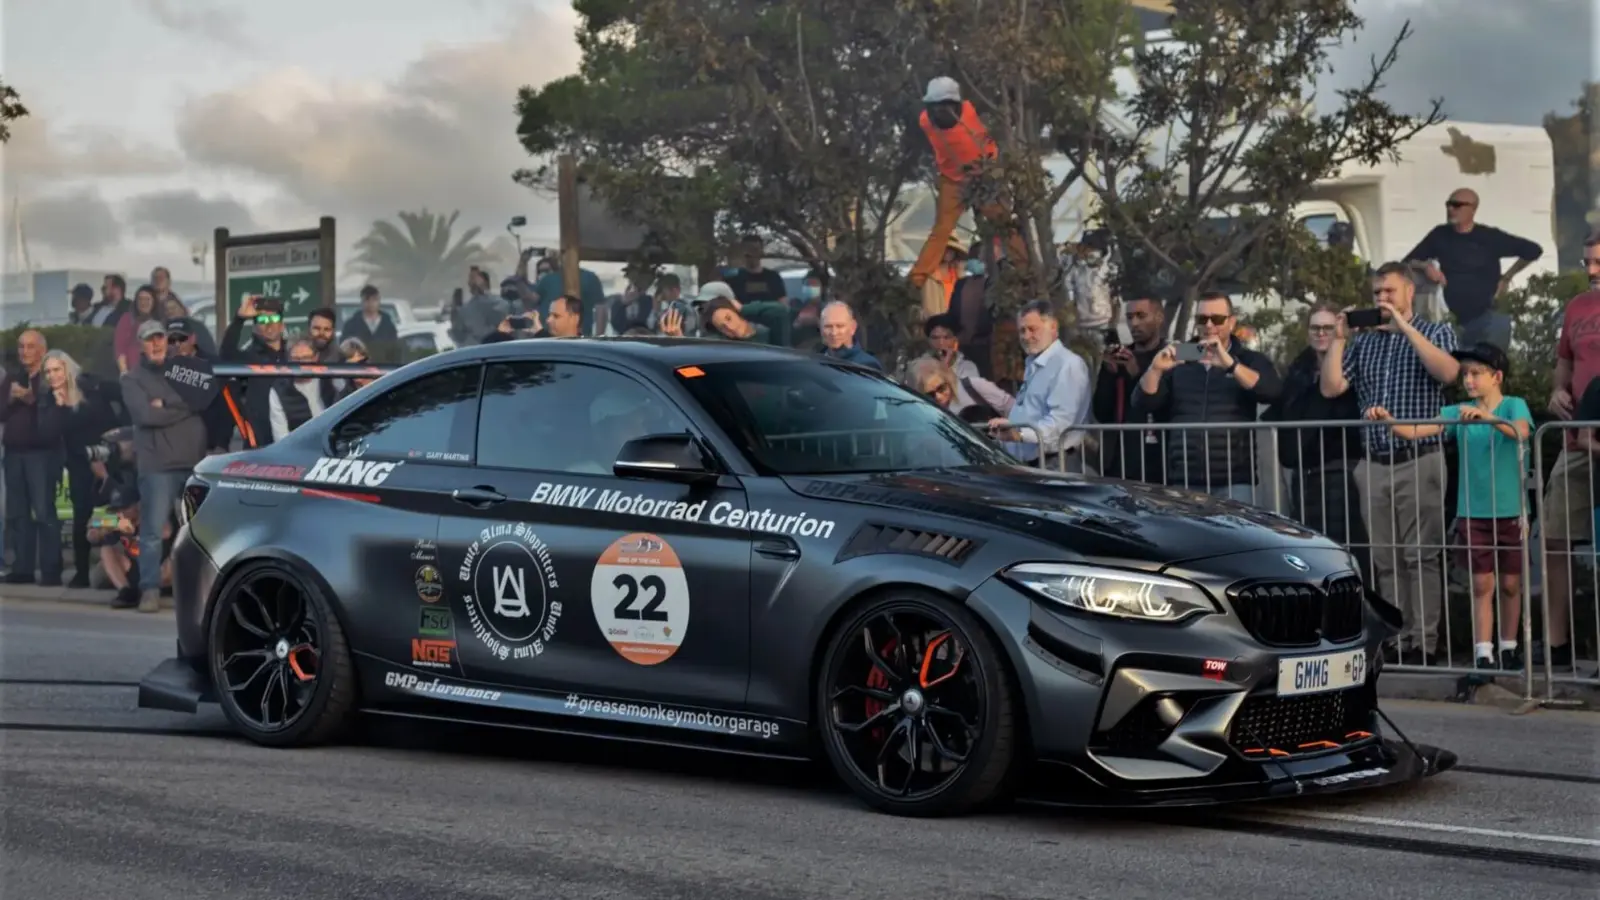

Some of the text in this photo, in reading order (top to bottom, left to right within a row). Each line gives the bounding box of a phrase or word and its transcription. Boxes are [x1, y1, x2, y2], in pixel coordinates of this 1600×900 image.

[262, 279, 281, 297] N2
[164, 370, 210, 390] PROJECTS
[303, 457, 396, 487] KING
[530, 482, 835, 539] BMW Motorrad Centurion
[458, 540, 481, 582] Unity
[479, 523, 512, 545] Alma
[612, 573, 668, 622] 22
[541, 600, 563, 642] Unity
[412, 638, 457, 662] NOS
[513, 638, 545, 659] Alma
[1205, 660, 1227, 671] TOW
[1295, 653, 1364, 690] GMMG GP
[385, 671, 502, 702] GMPerformance
[563, 692, 780, 739] #greasemonkeymotorgarage
